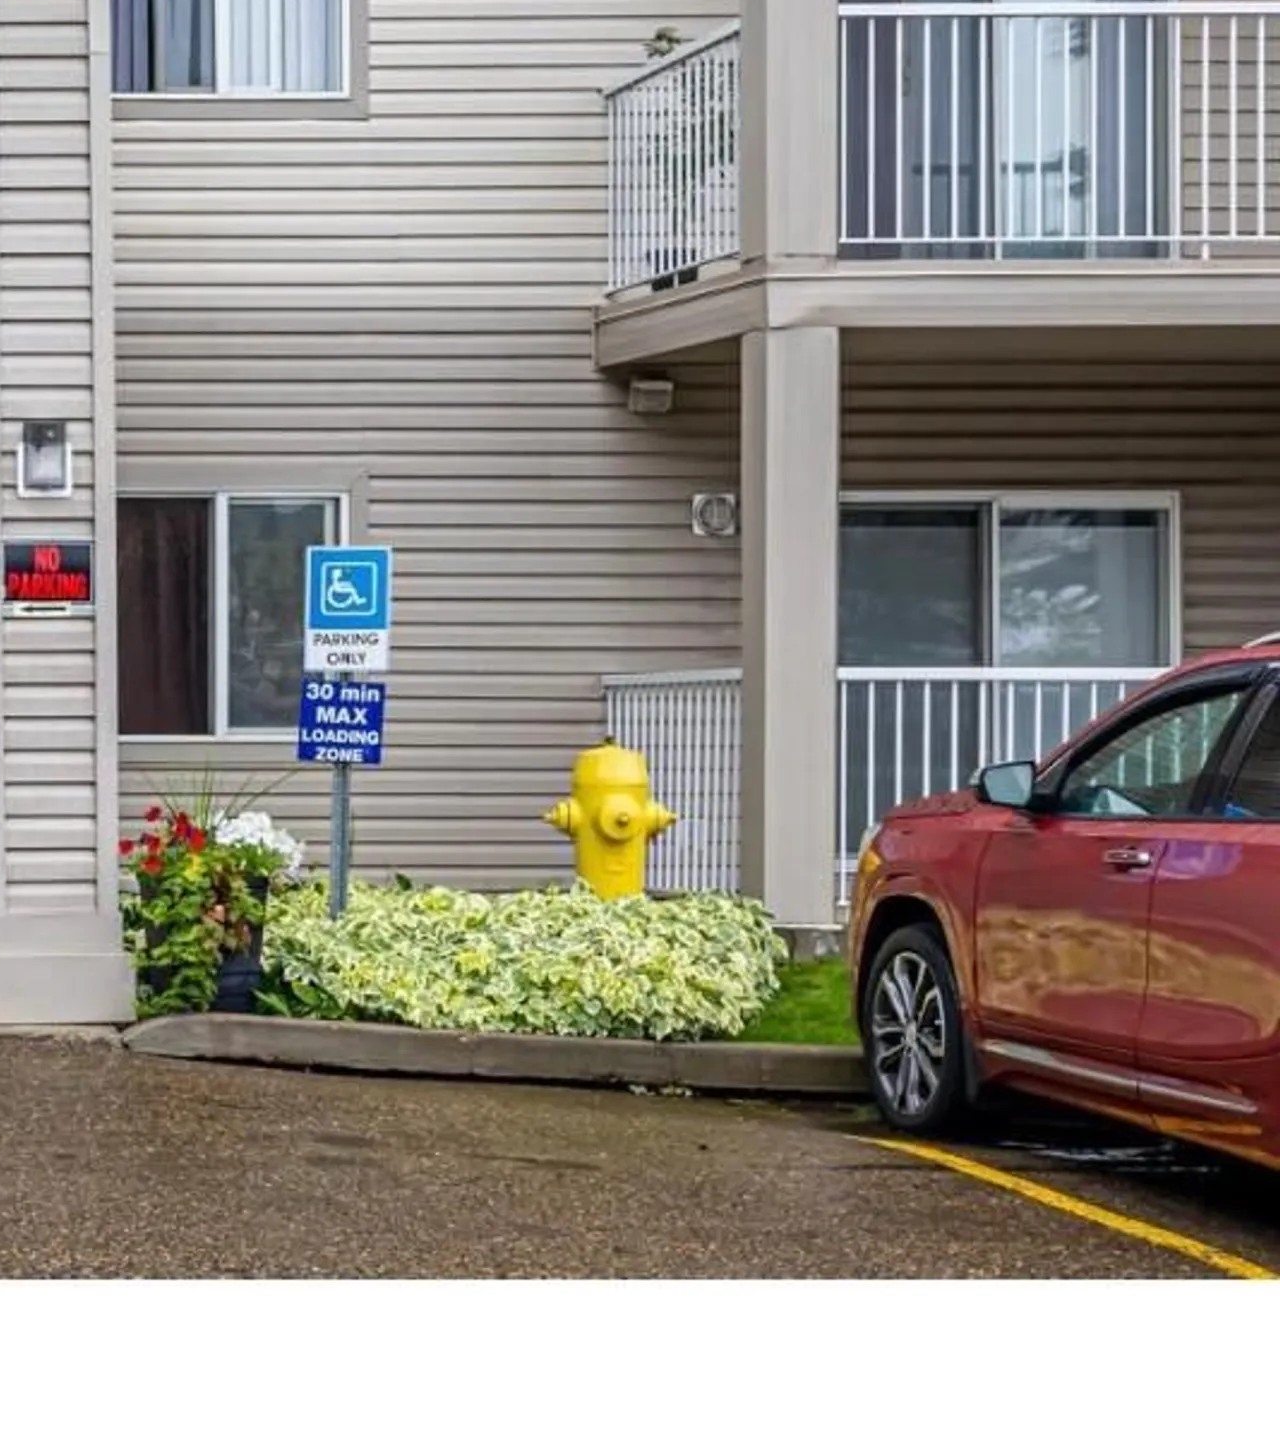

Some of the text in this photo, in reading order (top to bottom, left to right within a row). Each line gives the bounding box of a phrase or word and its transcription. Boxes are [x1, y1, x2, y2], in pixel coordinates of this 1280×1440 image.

[34, 545, 60, 572] NO
[7, 572, 88, 600] PARKING
[312, 632, 379, 647] PARKING
[326, 651, 367, 667] ONLY
[305, 683, 381, 703] 30 min
[315, 706, 369, 726] MAX
[300, 728, 380, 746] LOADING
[314, 746, 364, 762] ZONE
